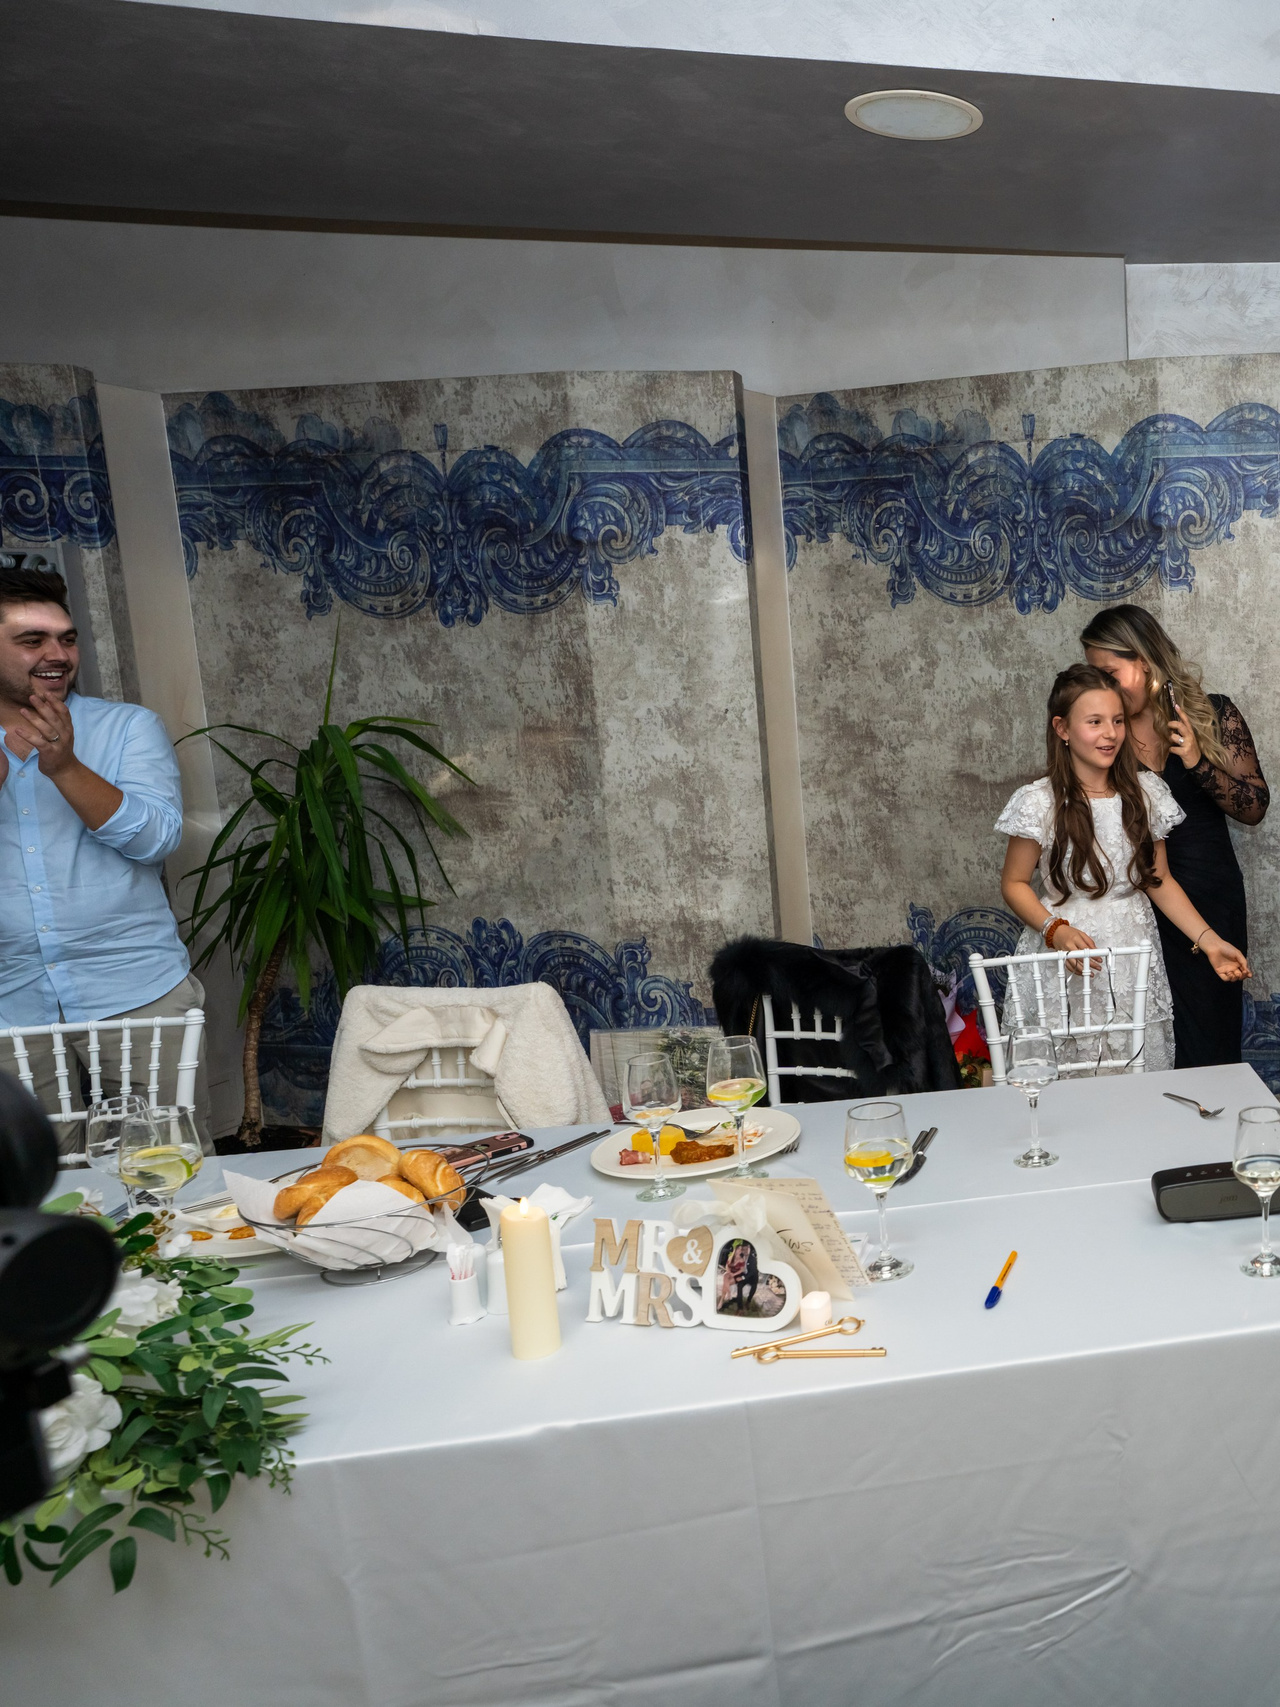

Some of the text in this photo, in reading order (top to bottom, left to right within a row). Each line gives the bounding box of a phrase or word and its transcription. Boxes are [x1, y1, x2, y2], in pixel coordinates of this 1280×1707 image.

[589, 1218, 703, 1274] MR &
[585, 1269, 703, 1328] MRS
